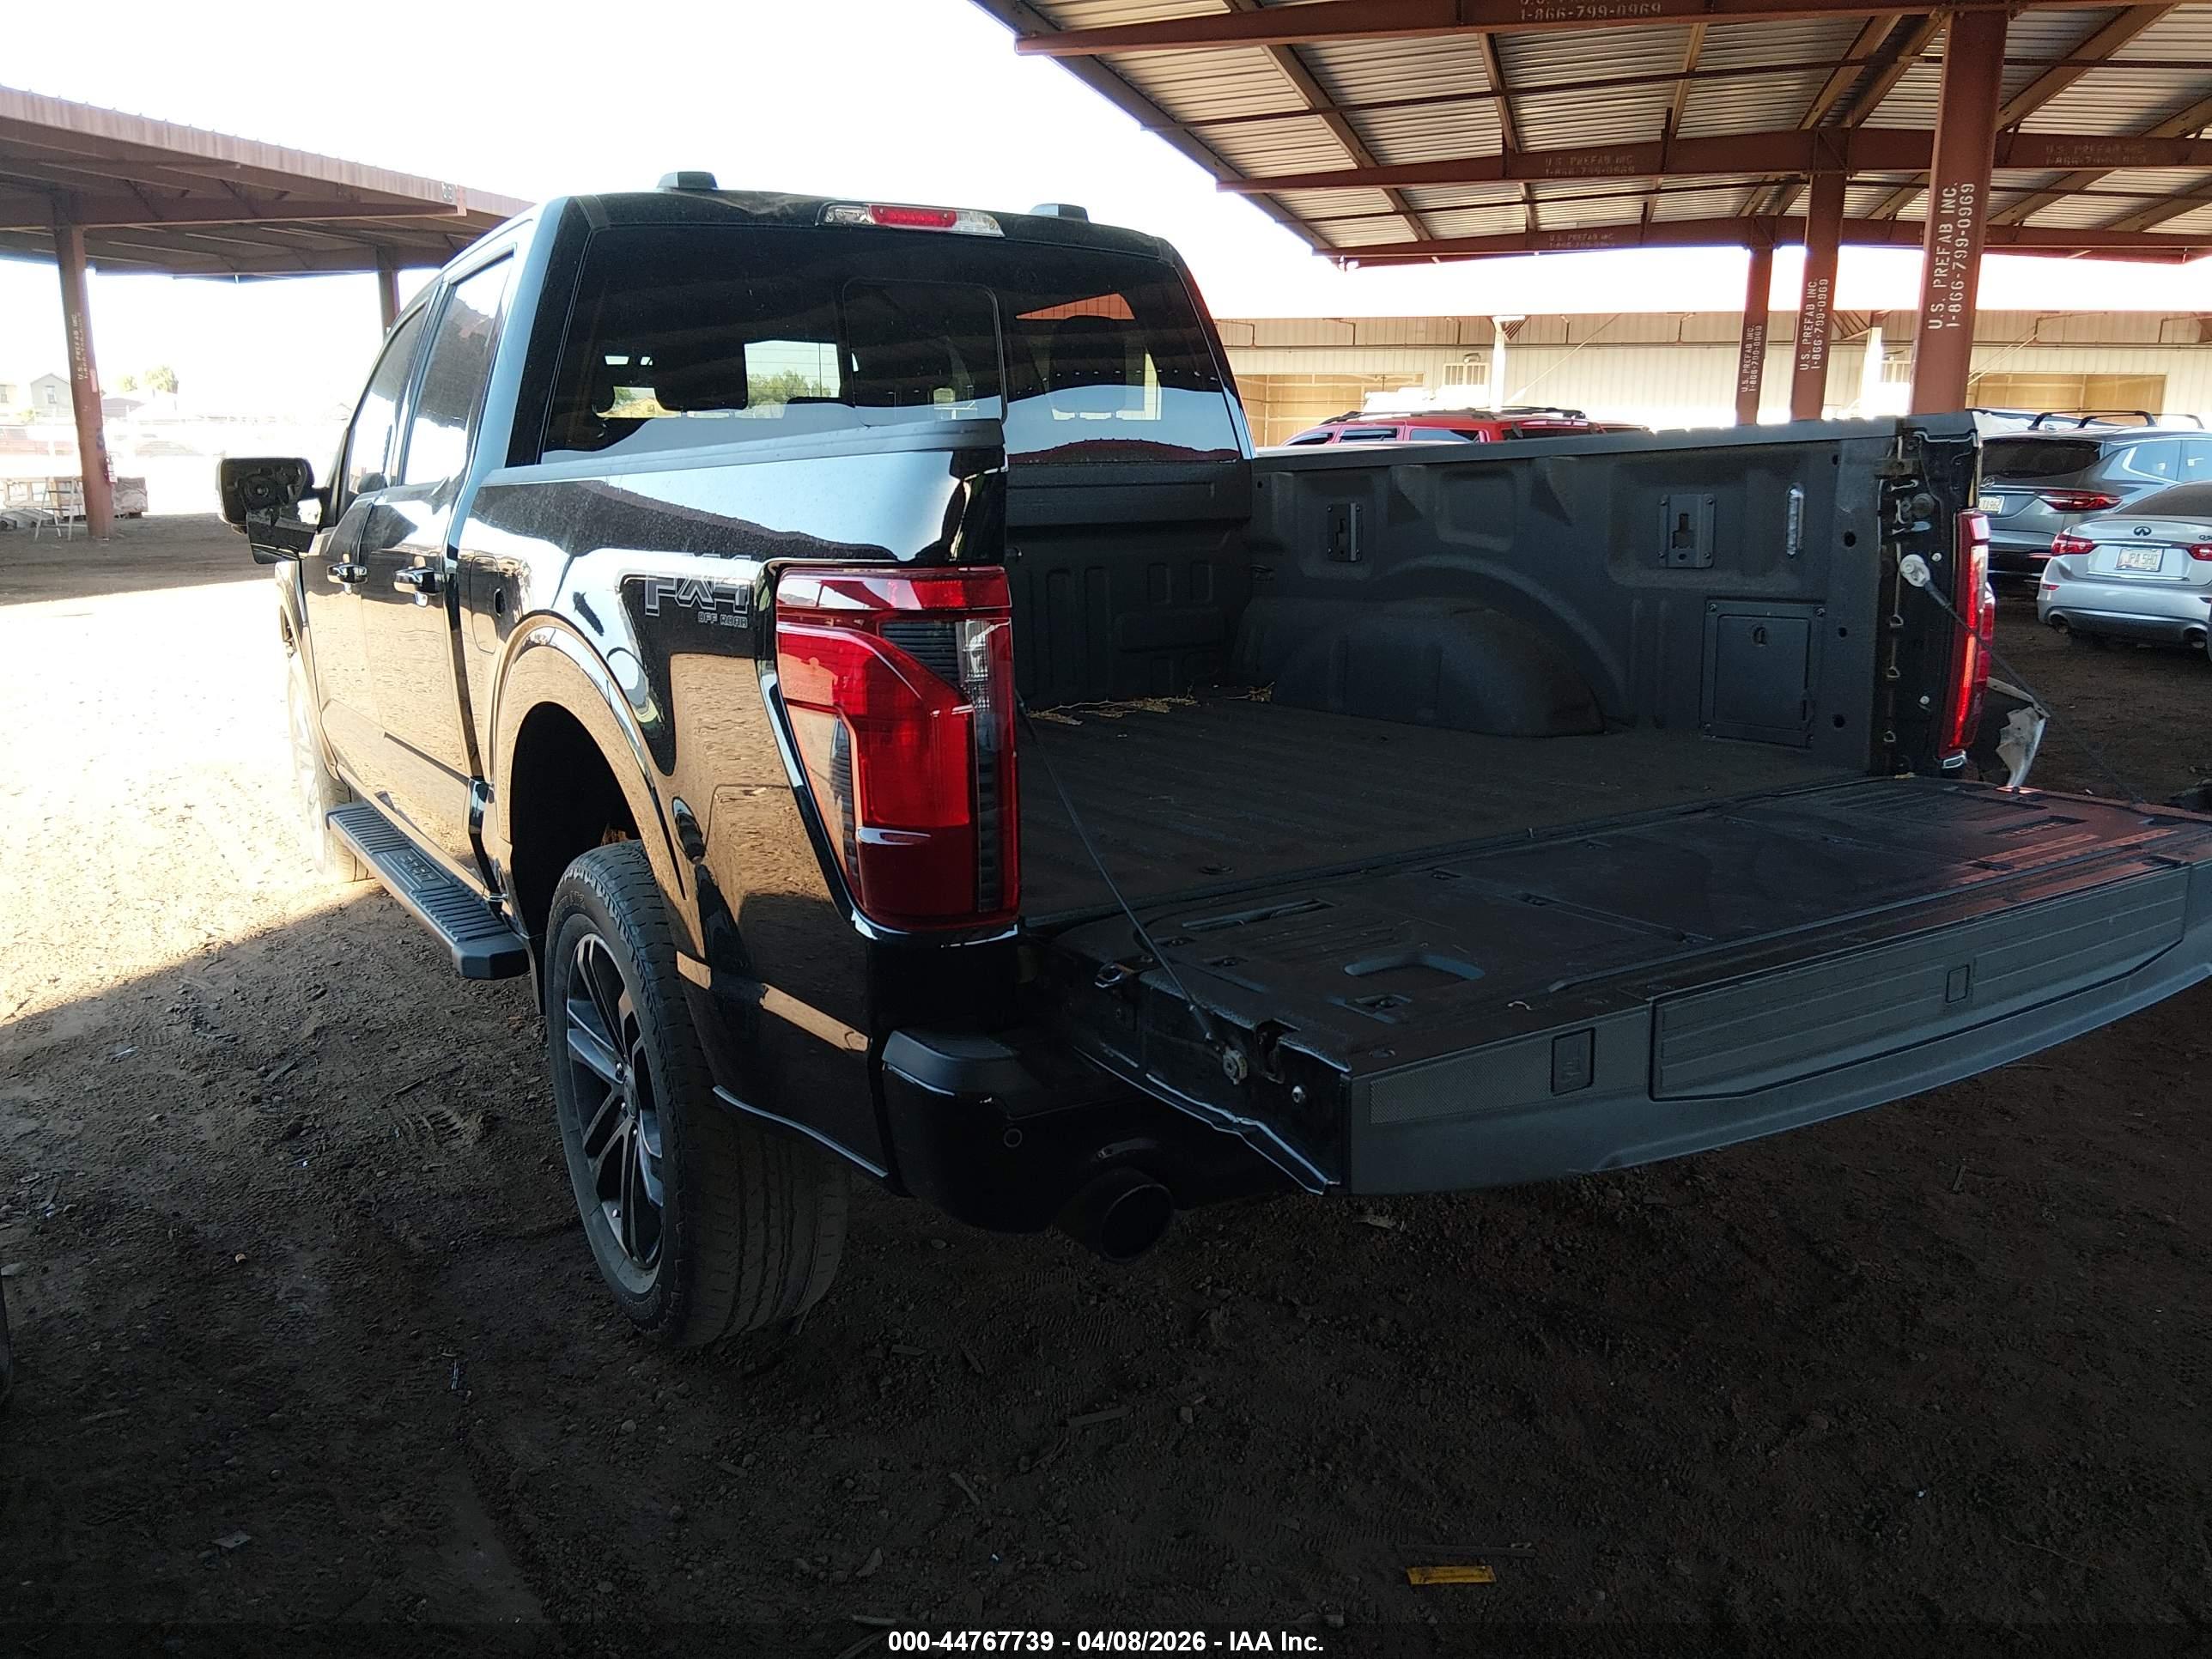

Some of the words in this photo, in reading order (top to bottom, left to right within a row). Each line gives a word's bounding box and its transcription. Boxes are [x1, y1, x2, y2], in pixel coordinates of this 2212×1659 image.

[1940, 182, 1958, 214] INC.
[1932, 223, 1954, 288] PREFAB
[1946, 183, 1975, 327] 1-866-799-0969
[1806, 277, 1818, 299] INC.
[1802, 303, 1815, 344] PREFAB
[1928, 298, 1947, 330] U.S.
[1742, 343, 1753, 374] PREFAB
[1799, 349, 1811, 370] U.S.
[697, 611, 718, 624] OFF
[720, 614, 749, 629] ROAD
